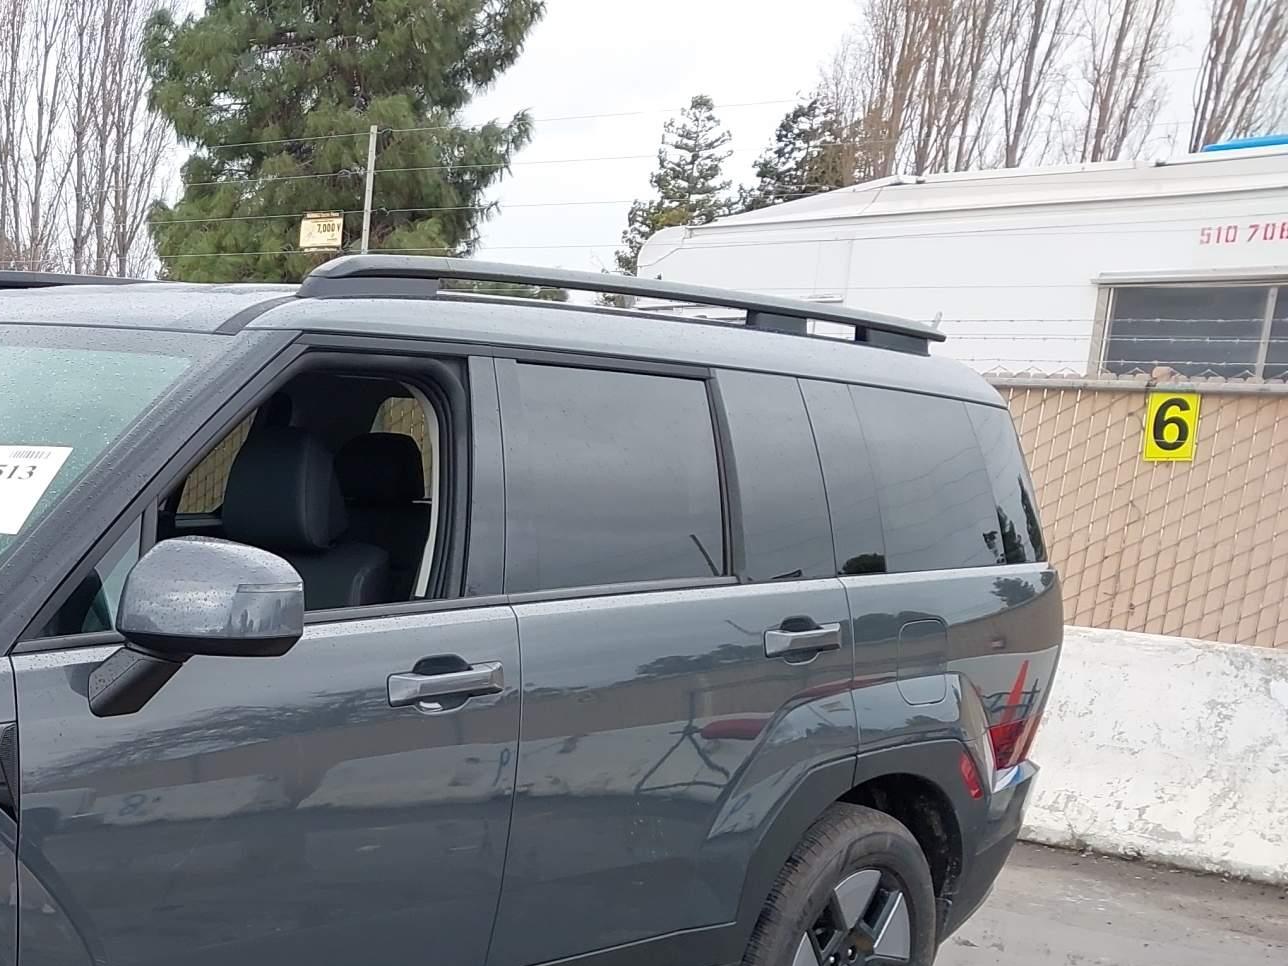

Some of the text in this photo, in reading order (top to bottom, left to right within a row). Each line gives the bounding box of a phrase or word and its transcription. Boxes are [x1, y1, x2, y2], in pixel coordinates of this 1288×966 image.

[316, 223, 336, 234] 7,000
[1200, 225, 1238, 245] 510
[1153, 397, 1191, 451] 6
